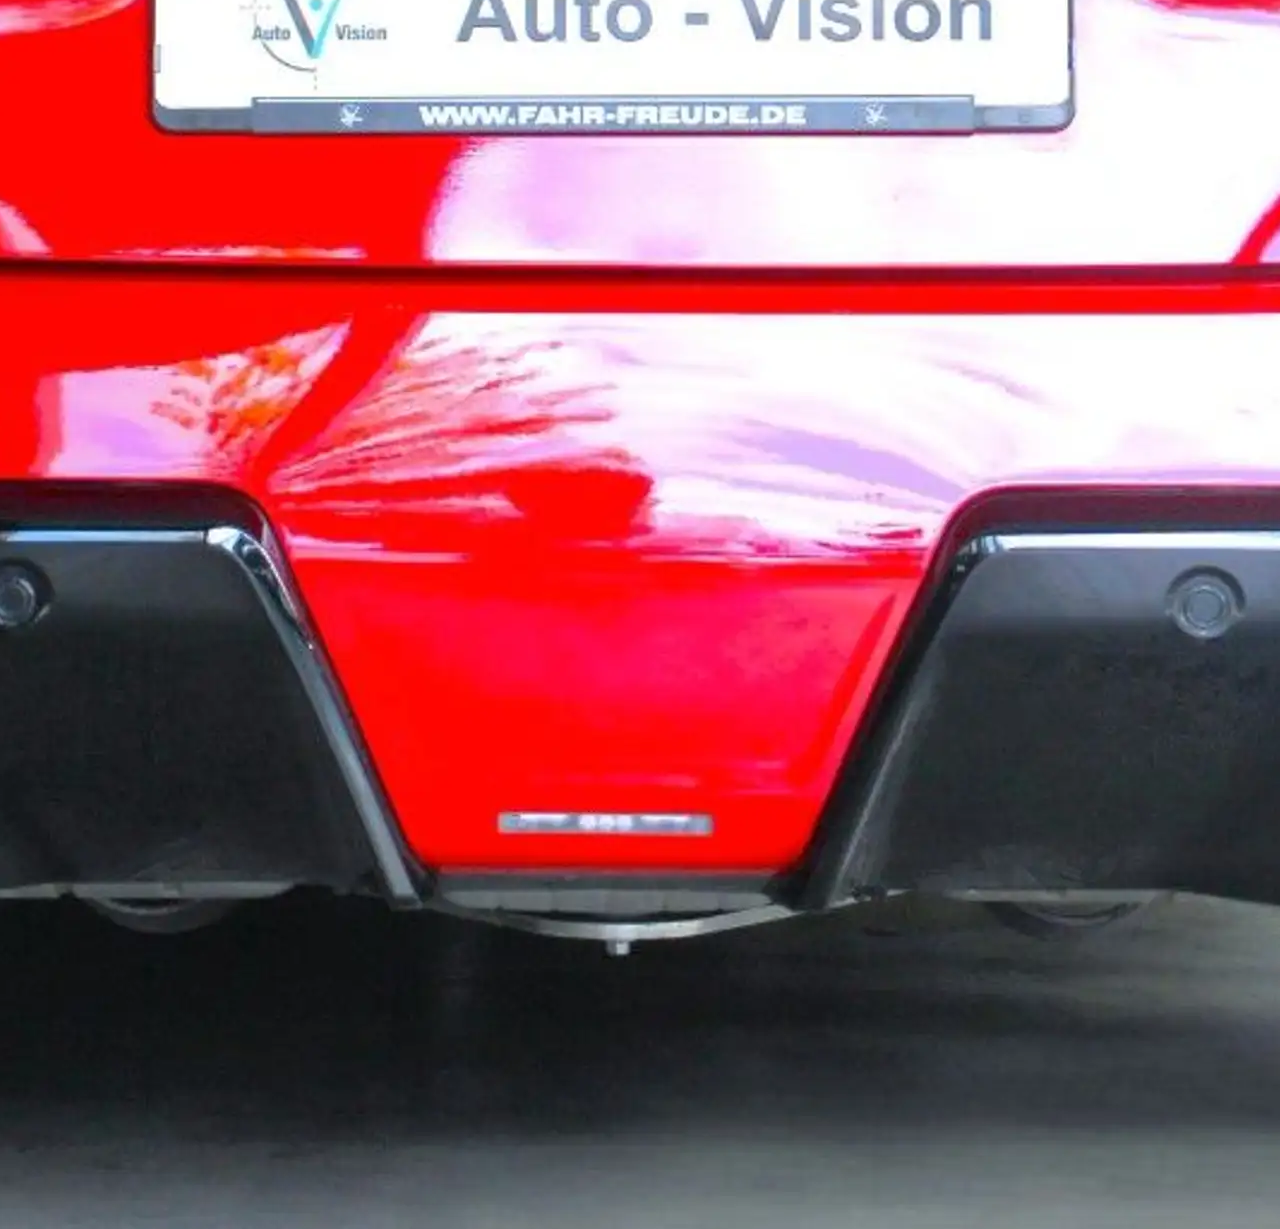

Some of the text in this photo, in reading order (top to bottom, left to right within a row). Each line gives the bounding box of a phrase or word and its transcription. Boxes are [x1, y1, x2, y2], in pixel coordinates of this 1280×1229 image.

[252, 23, 388, 41] Auto Vision
[419, 104, 807, 127] WWW.FAHR-FREUDE.DE
